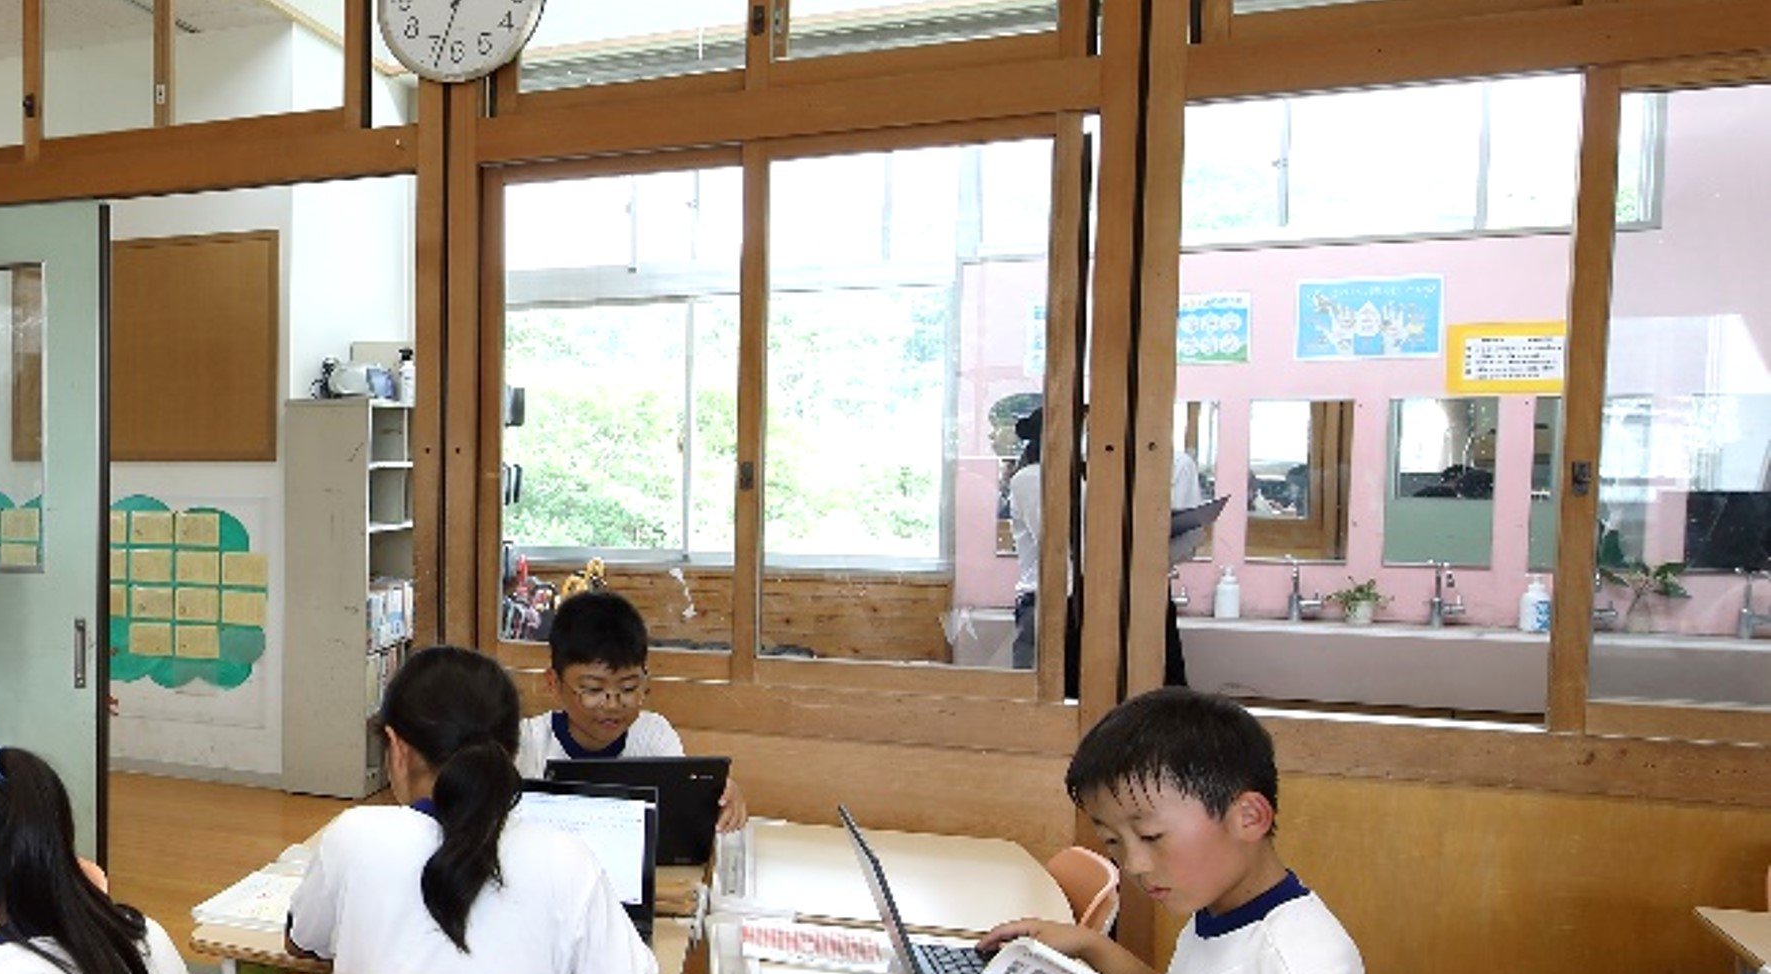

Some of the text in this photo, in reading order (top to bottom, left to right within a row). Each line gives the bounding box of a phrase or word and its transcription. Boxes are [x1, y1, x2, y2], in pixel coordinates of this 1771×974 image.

[404, 16, 420, 39] 8
[450, 40, 465, 64] 6
[478, 31, 493, 56] 5
[498, 10, 514, 32] 4
